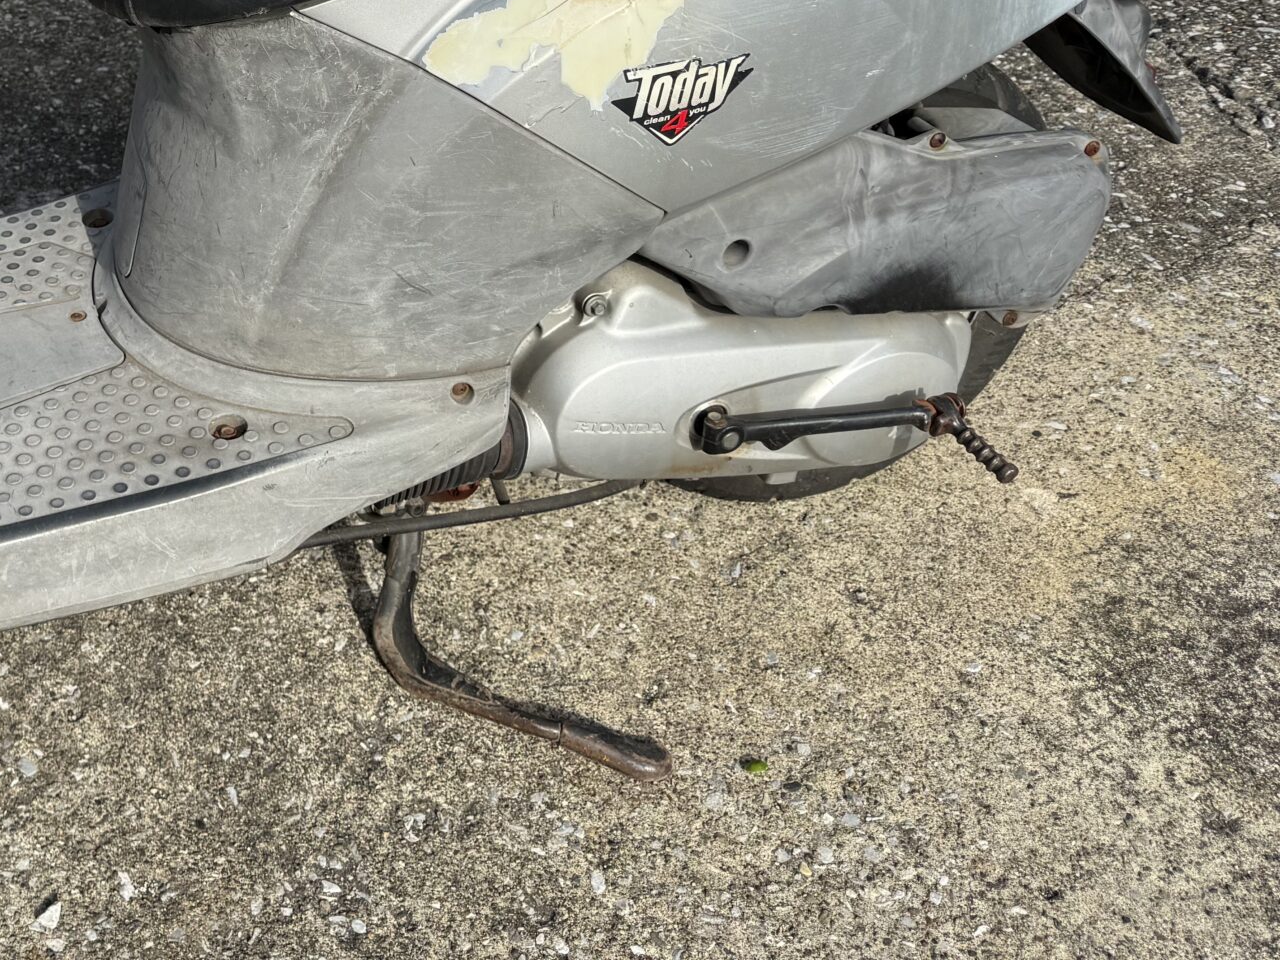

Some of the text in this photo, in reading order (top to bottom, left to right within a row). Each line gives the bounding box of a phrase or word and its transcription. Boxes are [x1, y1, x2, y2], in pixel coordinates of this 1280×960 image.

[627, 55, 747, 119] Today
[643, 106, 707, 134] clean 4 you
[574, 421, 666, 435] HONDA
